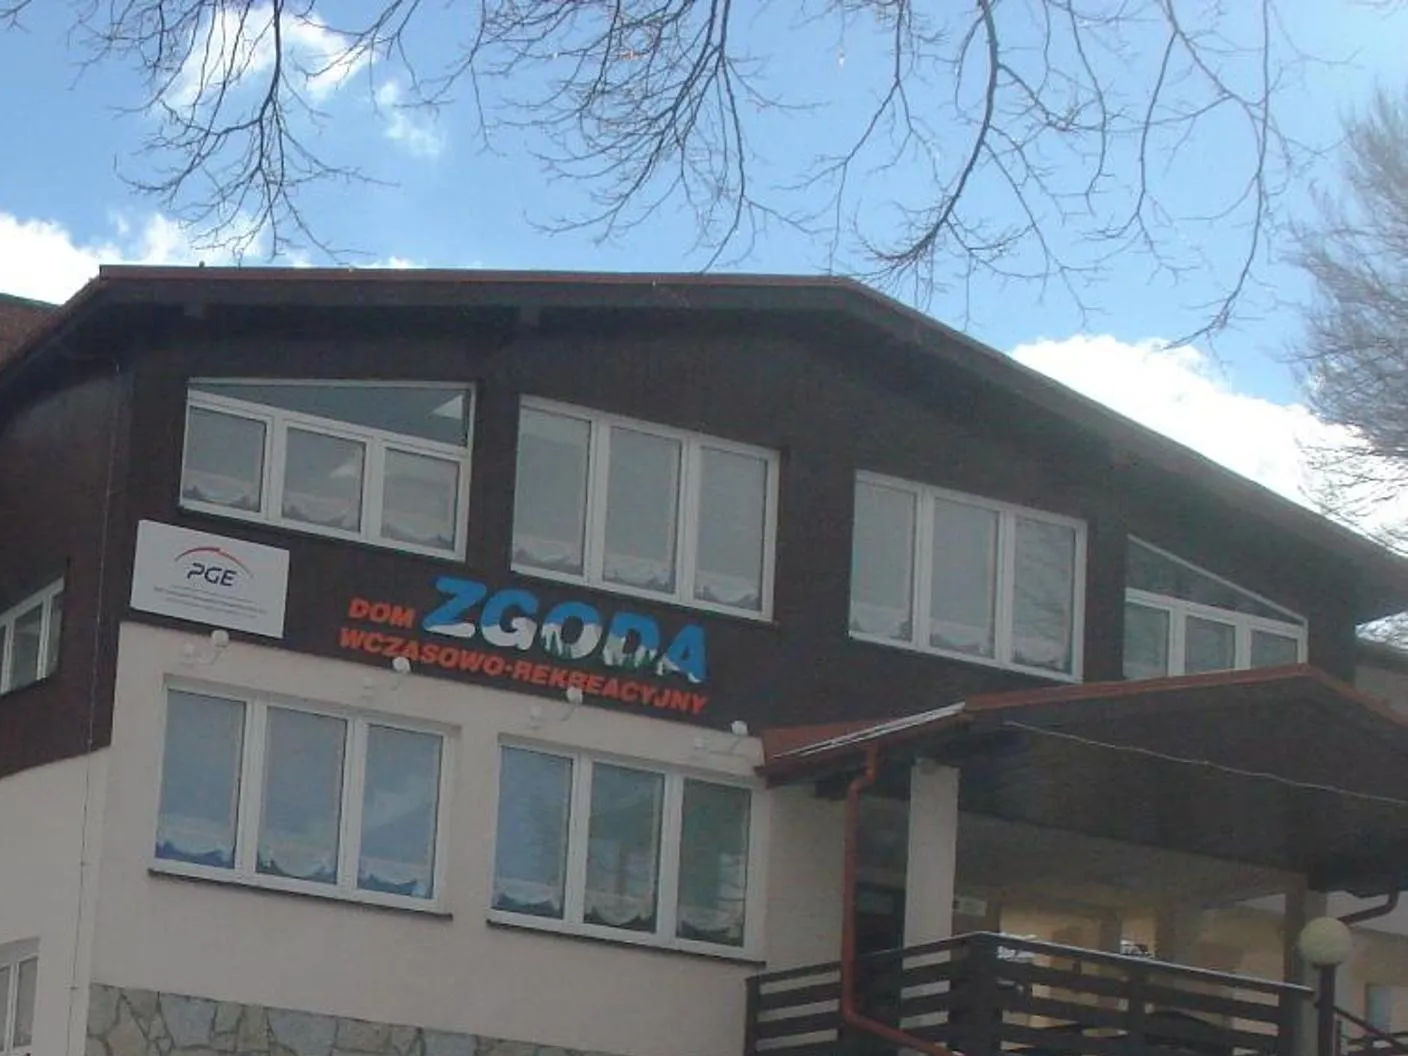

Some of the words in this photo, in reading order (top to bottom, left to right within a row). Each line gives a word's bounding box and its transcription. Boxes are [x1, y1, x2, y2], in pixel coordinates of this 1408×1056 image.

[187, 562, 238, 587] PGE
[339, 627, 710, 714] WCZASOWO-REKREACYJNY
[347, 597, 416, 629] DOM
[422, 574, 707, 684] ZGODA
